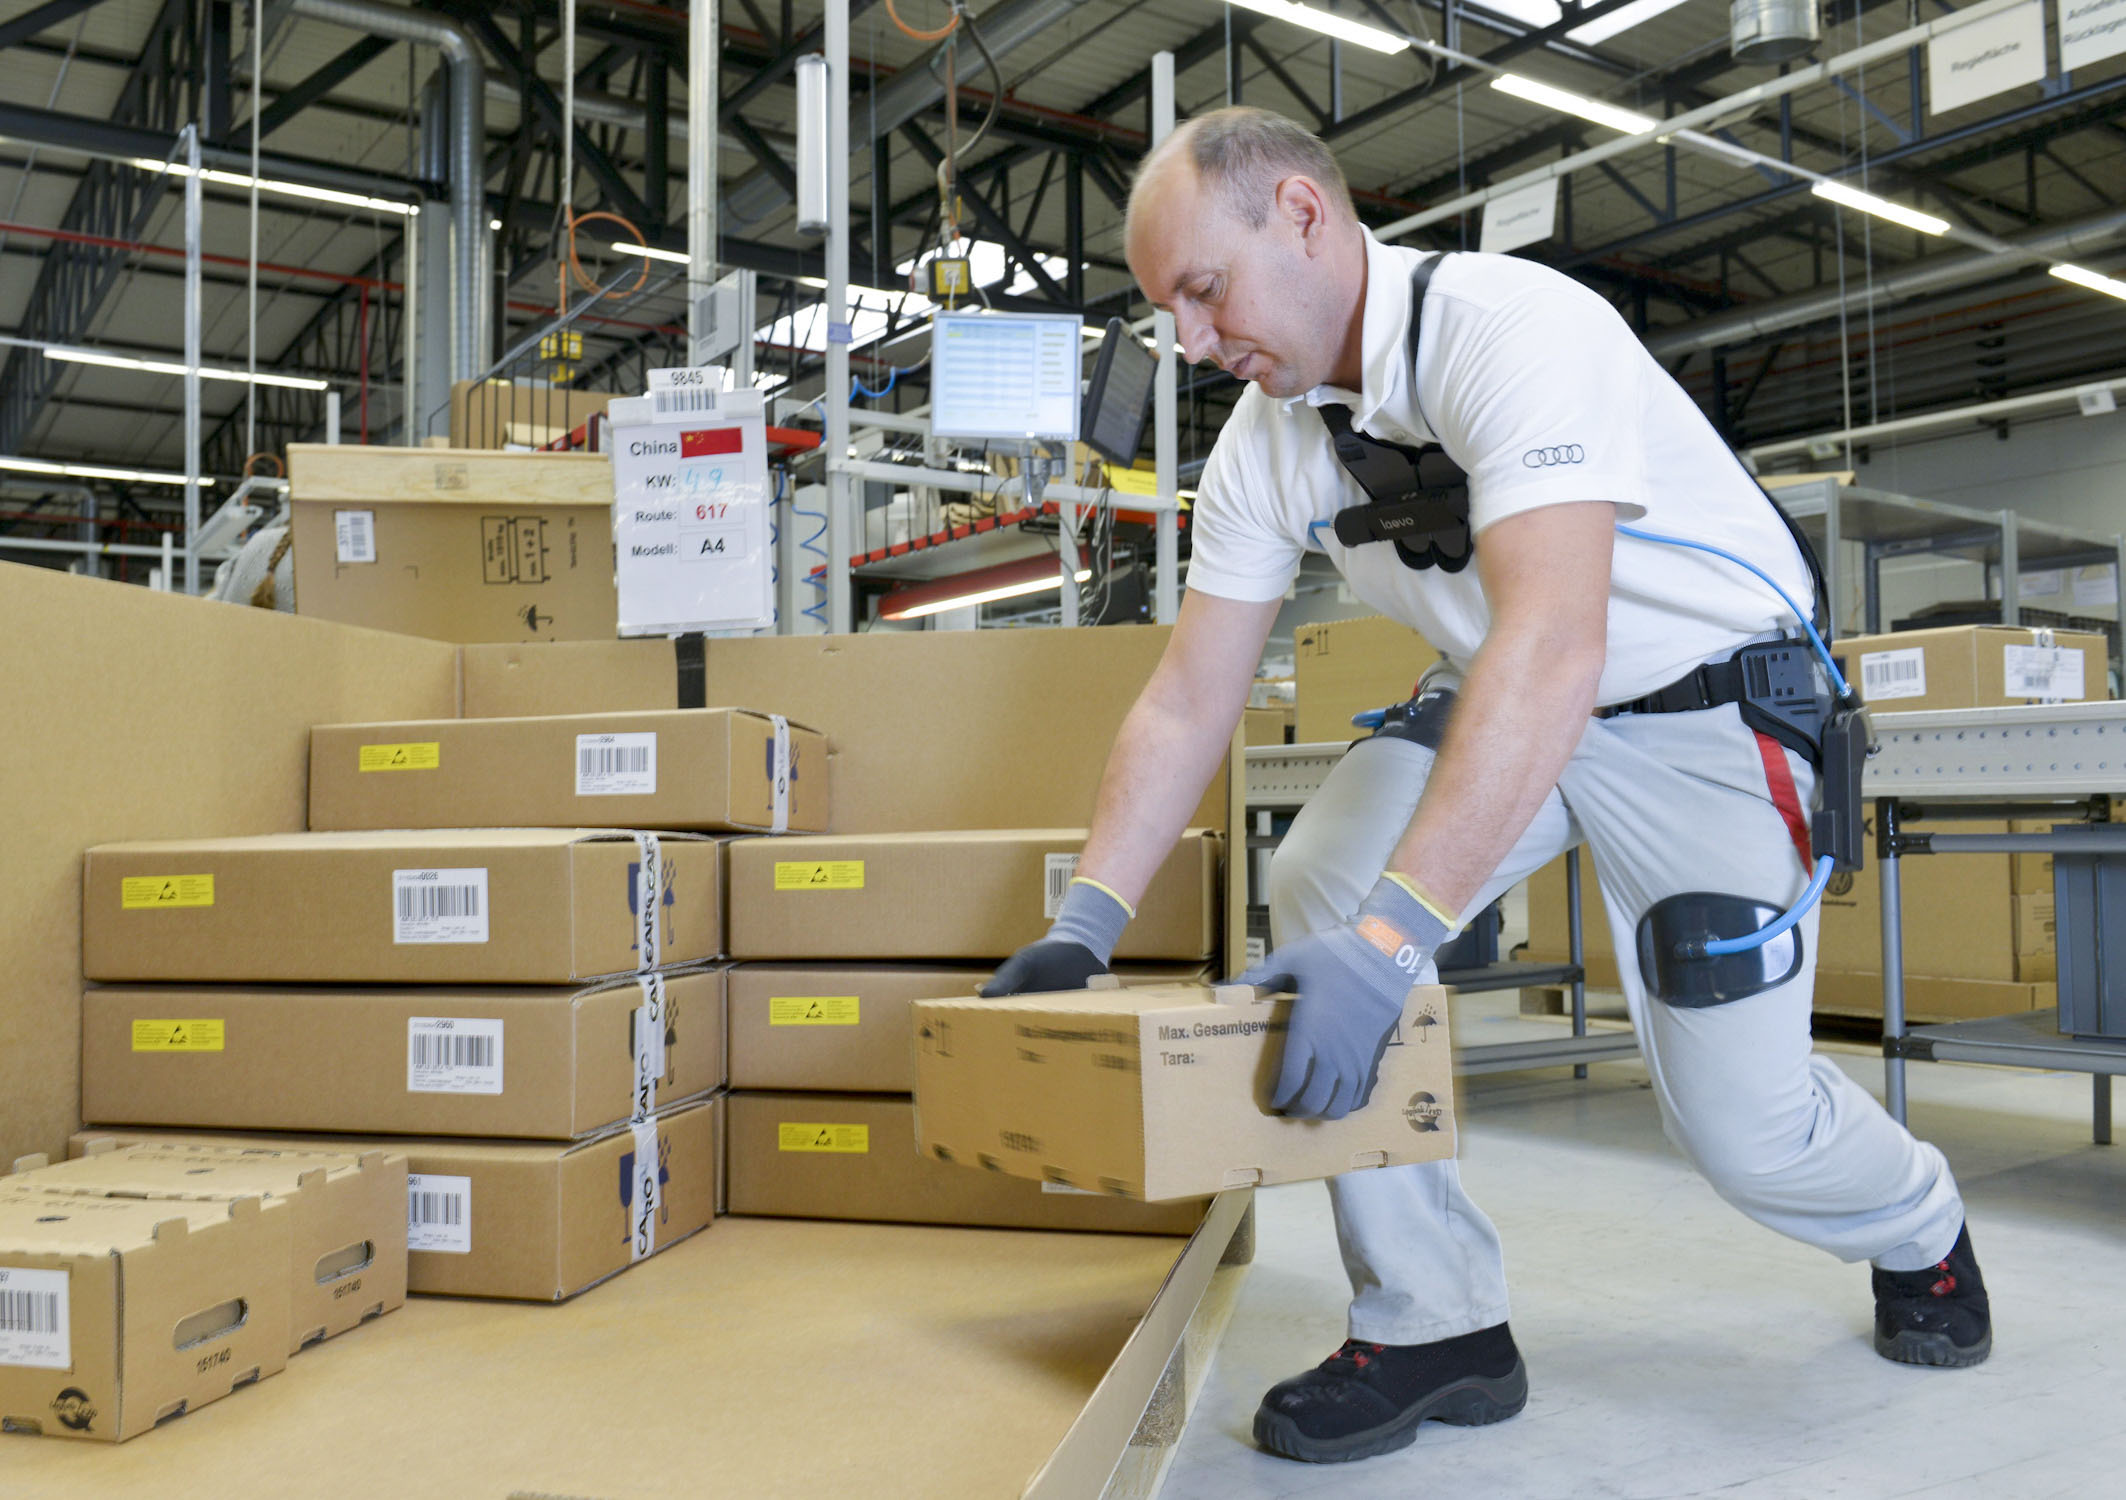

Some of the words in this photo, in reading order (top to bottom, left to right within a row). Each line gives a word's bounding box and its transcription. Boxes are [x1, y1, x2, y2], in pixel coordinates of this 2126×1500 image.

[671, 371, 703, 386] 9845
[630, 441, 678, 456] China
[646, 474, 677, 489] KW:
[685, 468, 724, 494] 49
[636, 510, 677, 522] Route:
[696, 503, 729, 521] 617
[632, 541, 678, 557] Modell:
[700, 537, 725, 555] A4
[1158, 1025, 1190, 1041] Max.
[1160, 1051, 1195, 1066] Tara:
[196, 1347, 232, 1376] 151740
